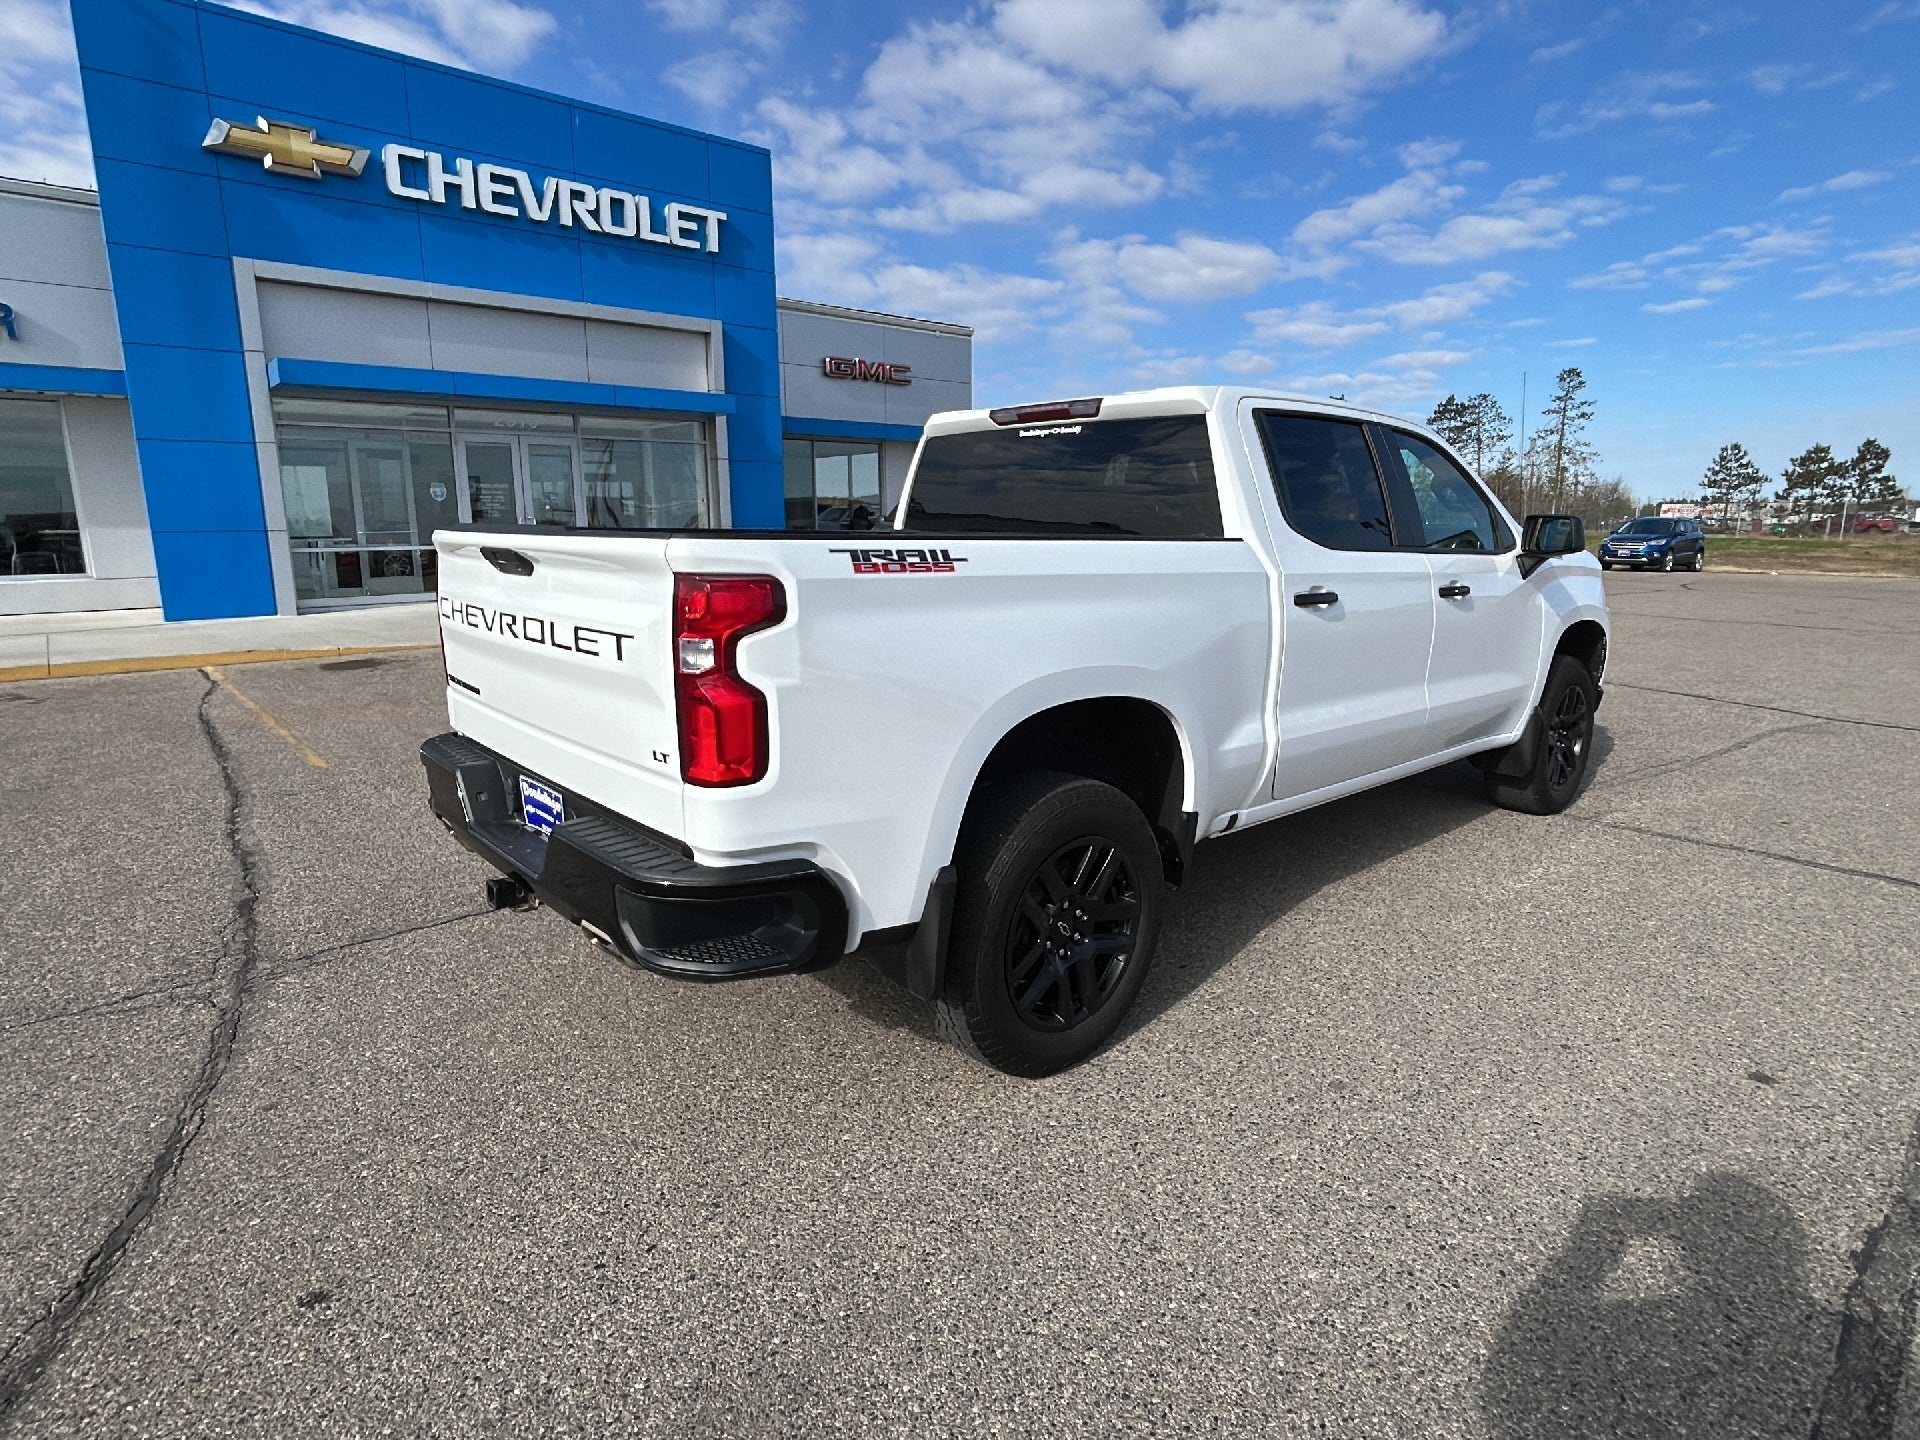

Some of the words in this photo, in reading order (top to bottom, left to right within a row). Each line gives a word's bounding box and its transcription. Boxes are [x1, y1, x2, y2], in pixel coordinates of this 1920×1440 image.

[381, 143, 727, 253] CHEVROLET
[824, 357, 912, 385] GMC
[828, 548, 968, 562] TRAIL
[853, 562, 955, 574] BOSS
[440, 596, 634, 661] CHEVROLET
[653, 750, 670, 764] LT
